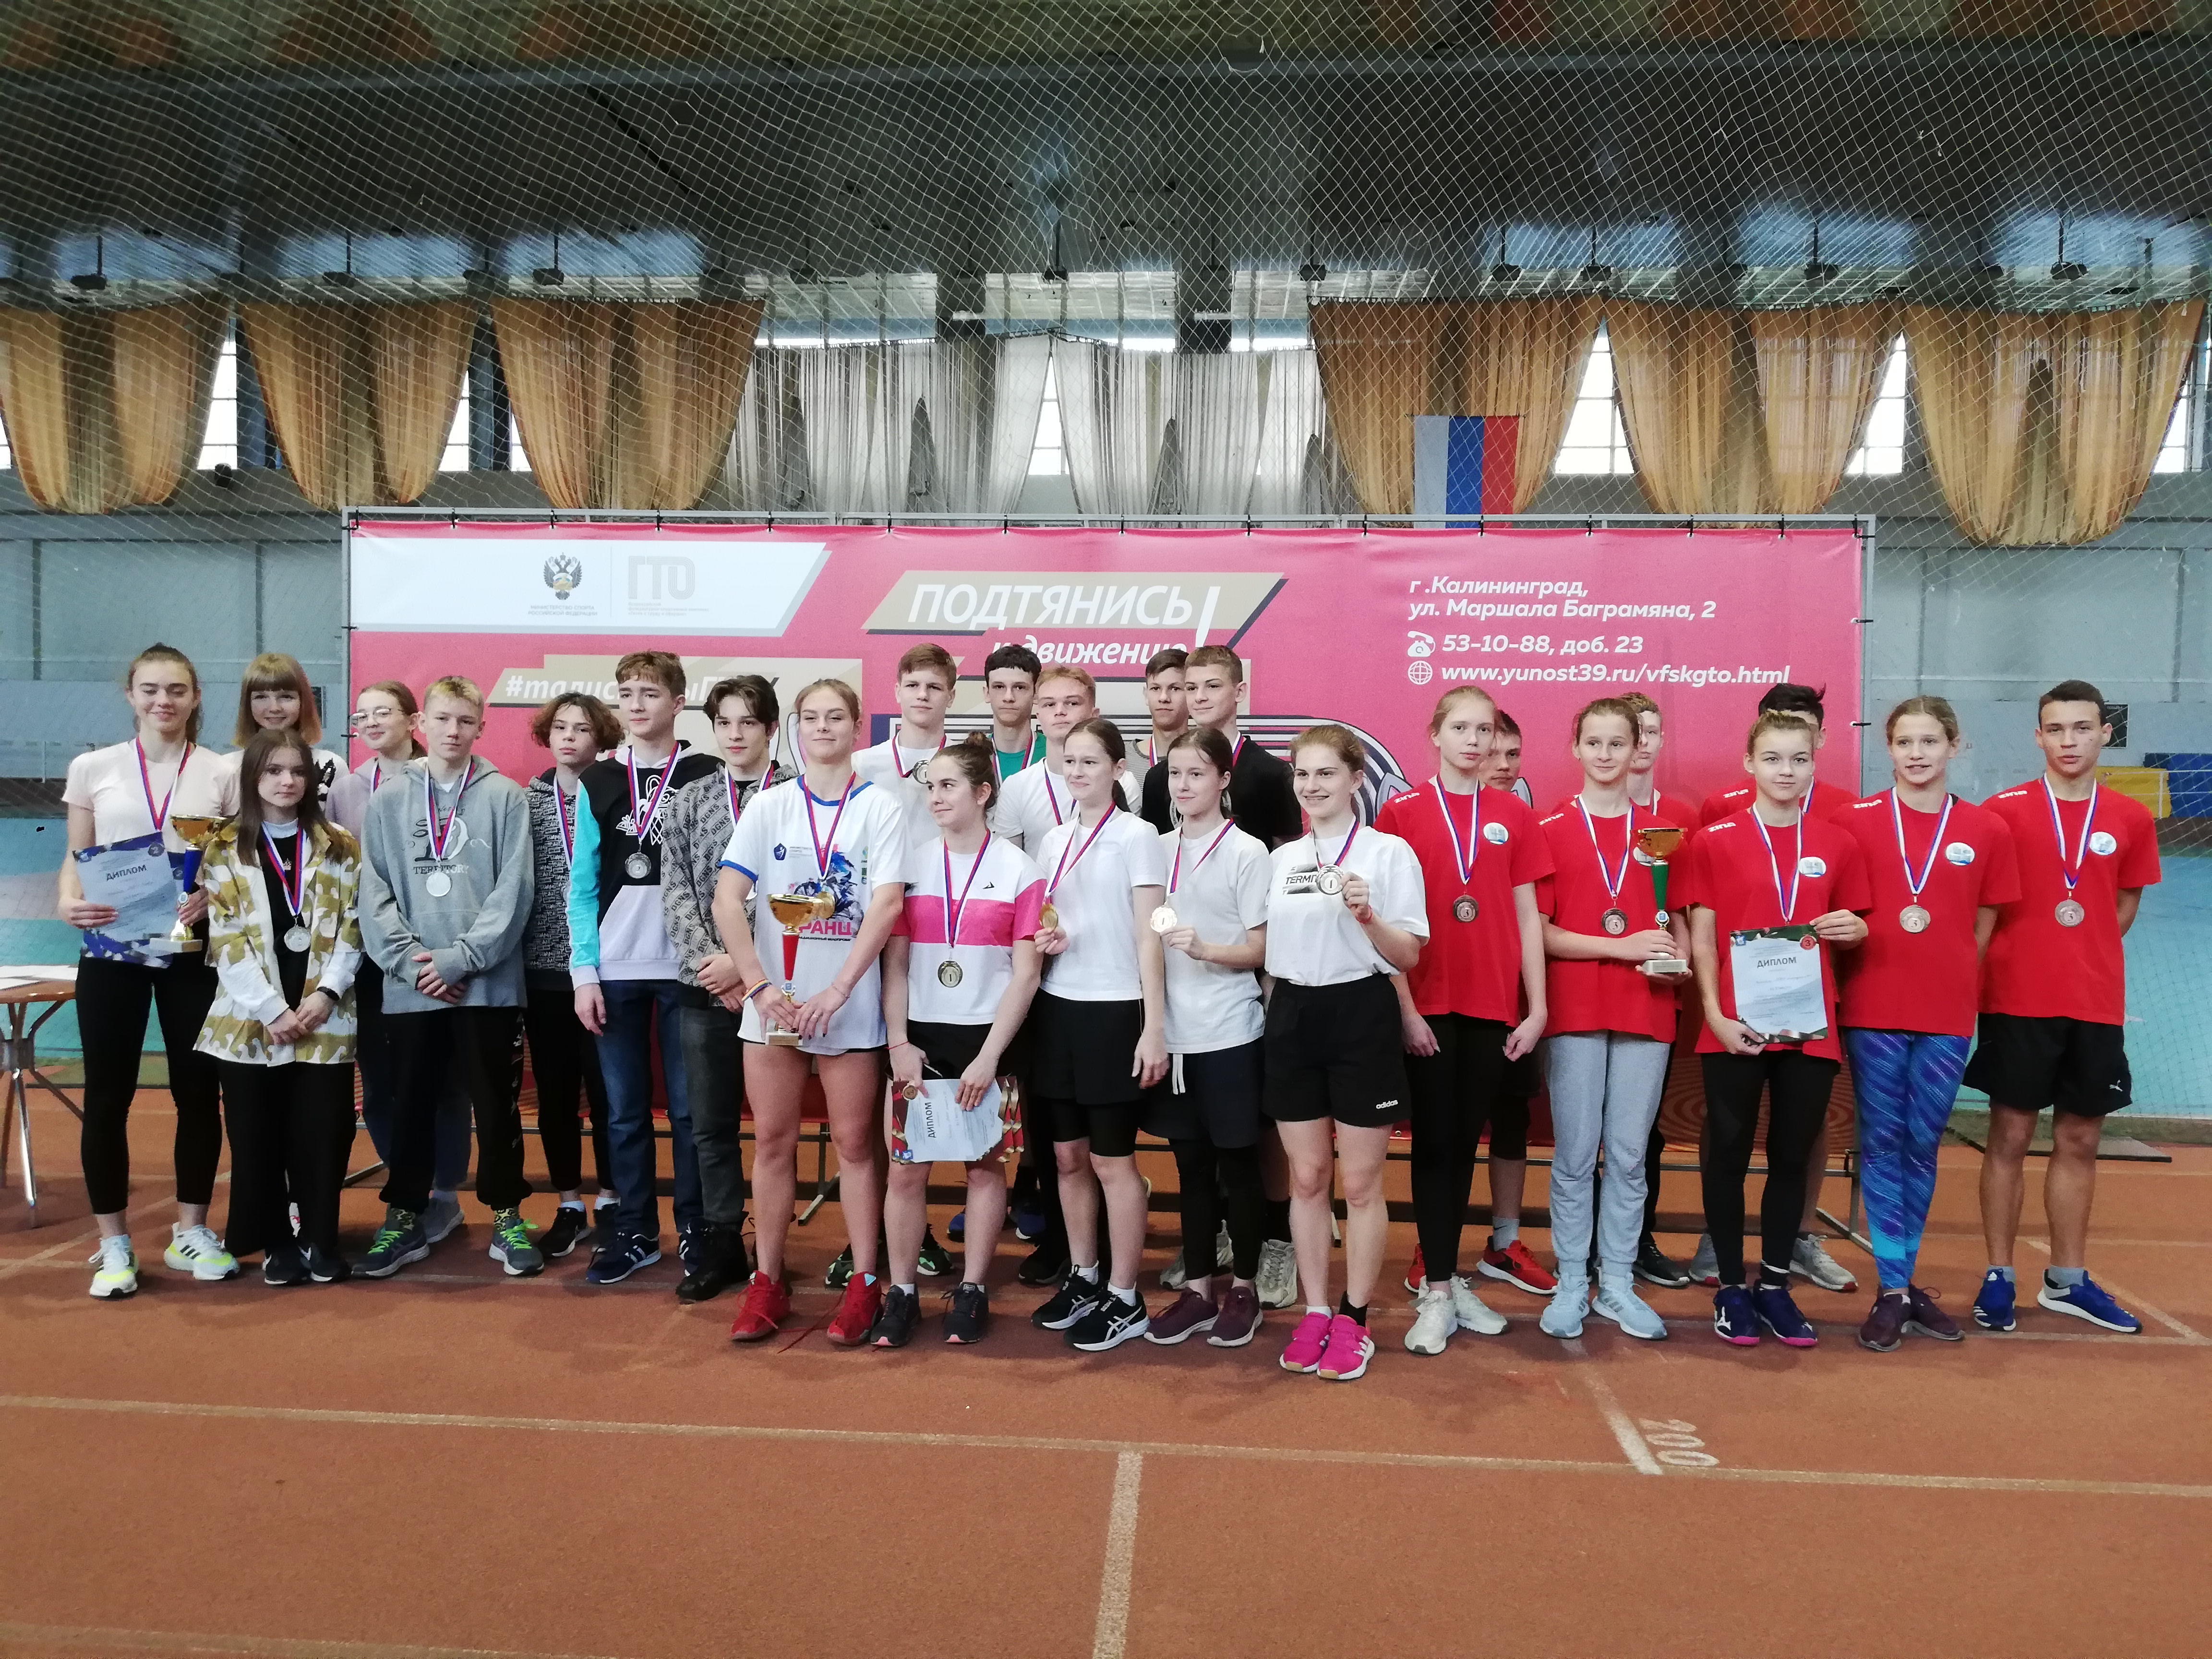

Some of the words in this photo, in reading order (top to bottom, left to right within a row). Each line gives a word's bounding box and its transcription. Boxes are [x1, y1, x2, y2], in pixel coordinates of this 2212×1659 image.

[1408, 603, 1440, 621] ул.
[1446, 599, 1558, 617] Маршала
[1563, 600, 1695, 621] Баграмяна,
[1701, 601, 1717, 618] 2
[1442, 634, 1555, 656] 53-10-88,
[1559, 640, 1609, 655] доб.
[1614, 636, 1644, 653] 23
[1442, 663, 1791, 688] www.yunost39.ru/vfskgto.html
[700, 803, 720, 824] DGNS
[711, 816, 731, 836] DGNS
[151, 846, 159, 854] 2
[106, 864, 147, 881] ДИПЛОМ
[696, 865, 713, 887] DGNS
[671, 891, 690, 912] DGNS
[787, 920, 853, 936] РАНЦ
[1757, 957, 1797, 968] ДИПЛОМ
[1376, 1099, 1398, 1109] adidas
[925, 1102, 937, 1139] ДИПЛОМ
